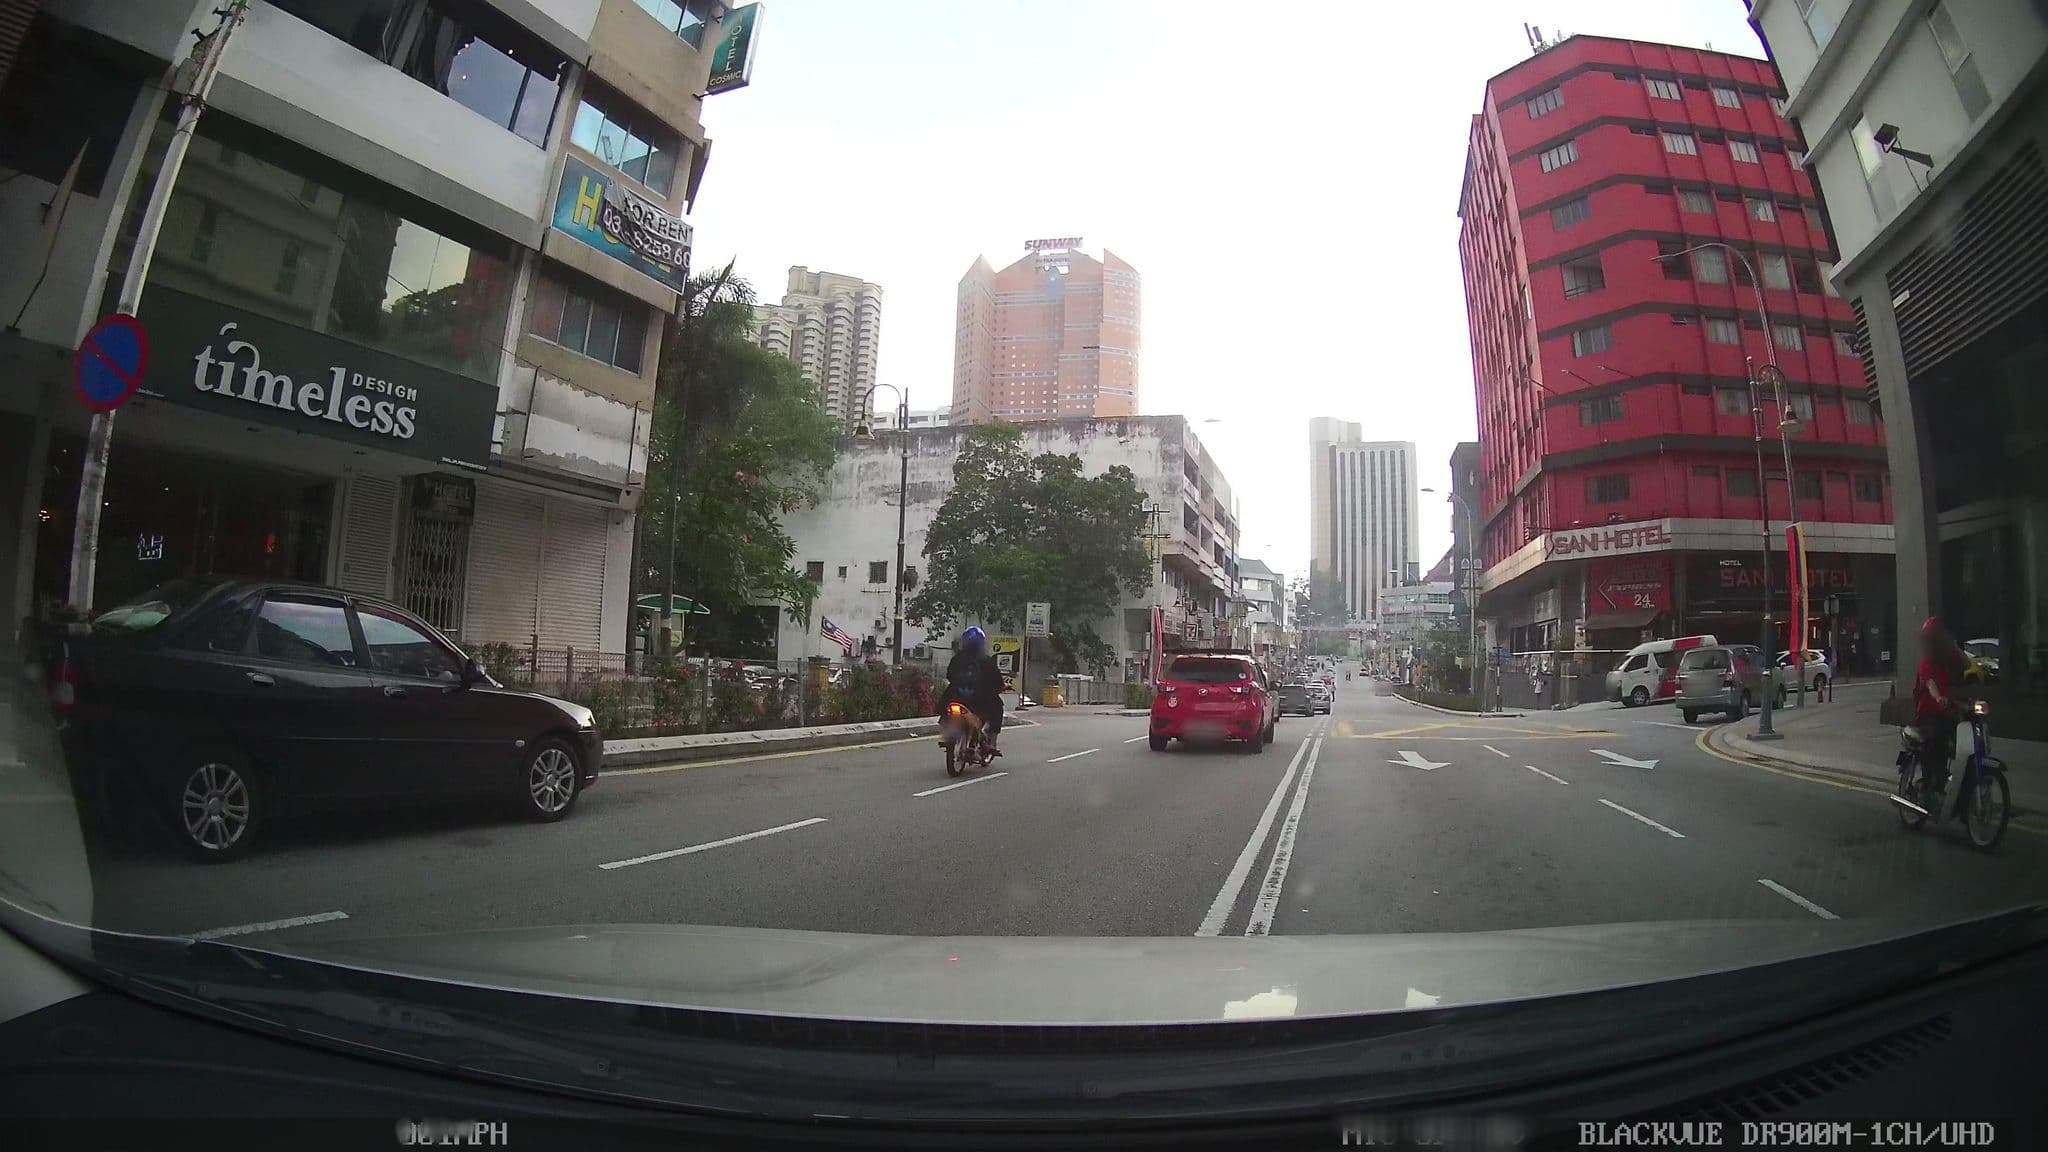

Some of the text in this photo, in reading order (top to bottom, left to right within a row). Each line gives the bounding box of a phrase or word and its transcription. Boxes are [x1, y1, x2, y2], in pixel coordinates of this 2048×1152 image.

[724, 14, 743, 72] OTEL
[709, 70, 742, 86] COSMIC
[658, 215, 693, 241] REN
[1024, 237, 1083, 251] SUNWAY
[195, 322, 417, 439] timeless
[352, 372, 418, 402] DESIGN
[1603, 525, 1672, 550] HOTEL
[1634, 593, 1650, 606] 24
